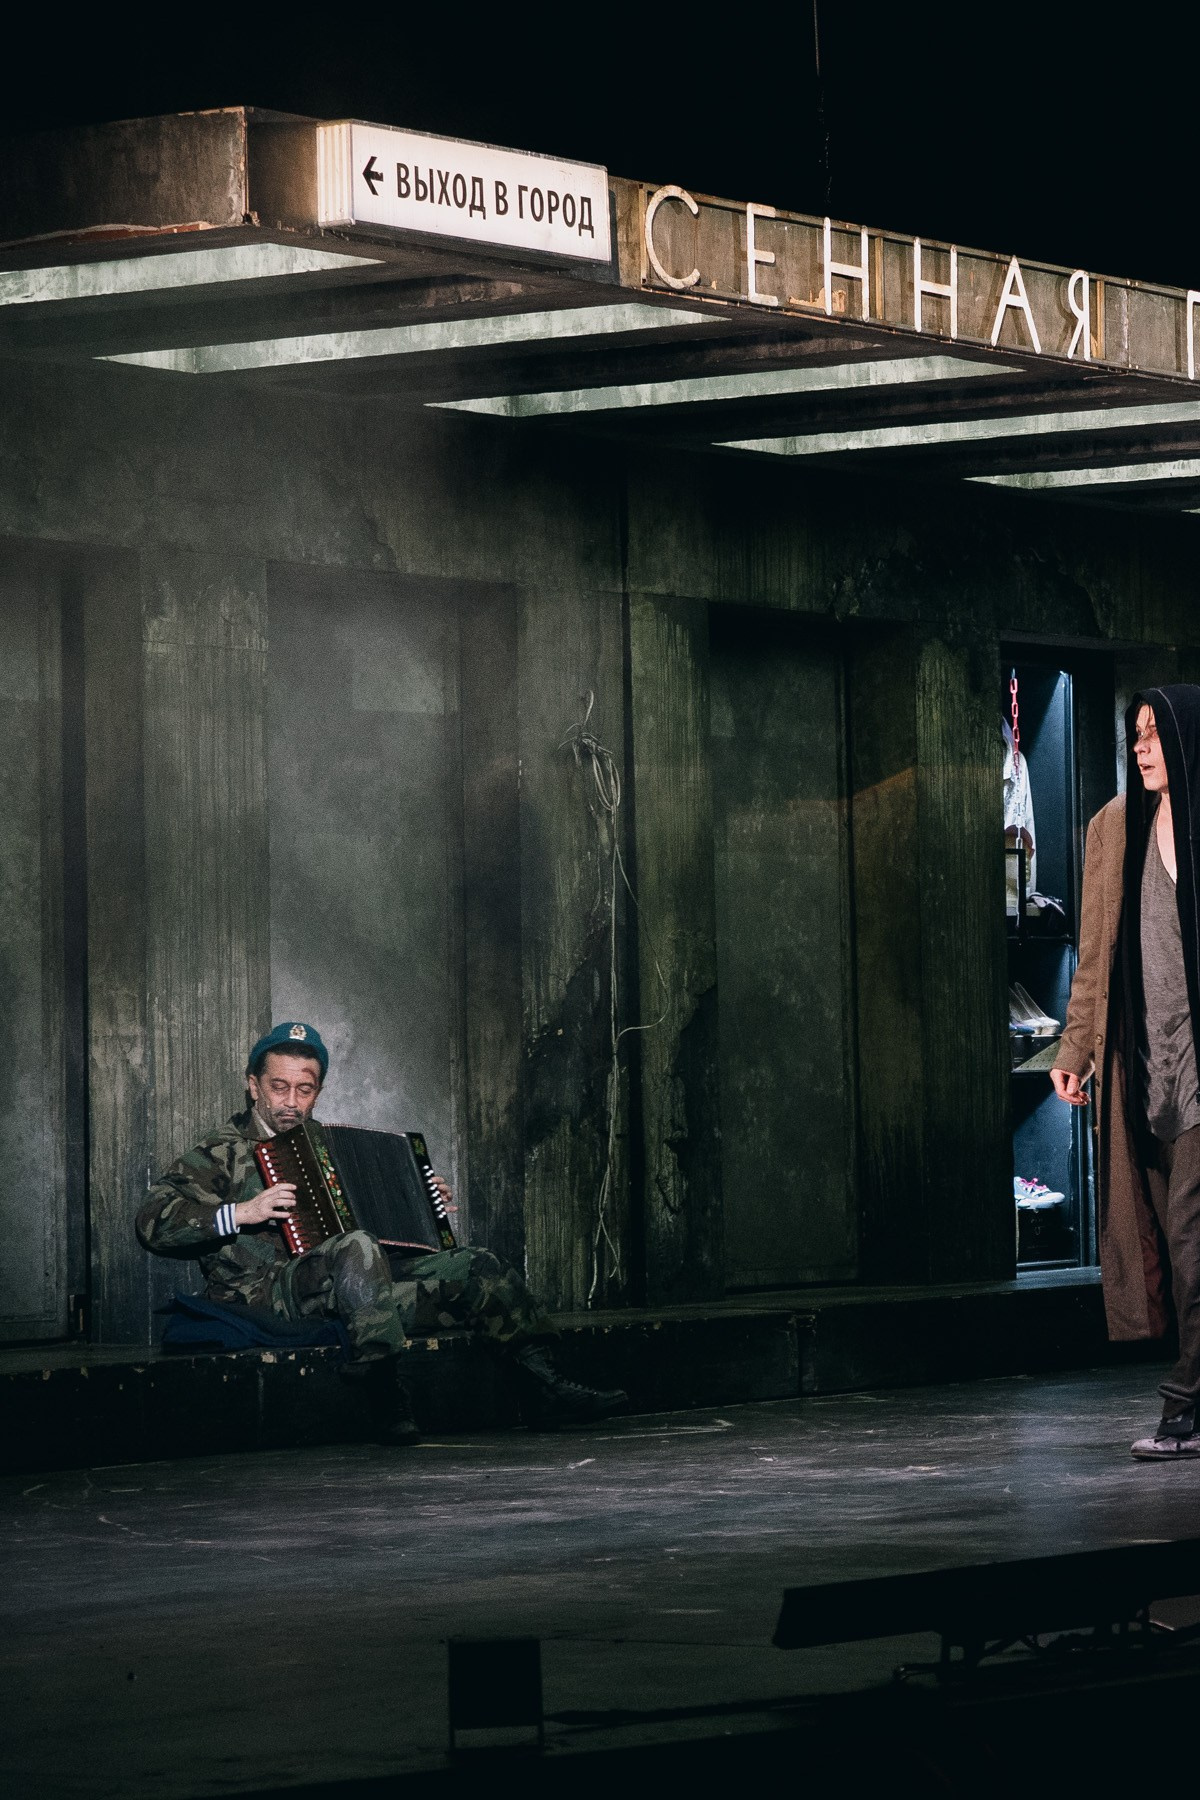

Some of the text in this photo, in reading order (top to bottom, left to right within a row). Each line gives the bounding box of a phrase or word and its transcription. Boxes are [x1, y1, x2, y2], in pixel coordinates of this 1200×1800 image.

[396, 163, 595, 239] ВЫХОД В ГОРОД
[645, 185, 1091, 361] СЕННАЯ
